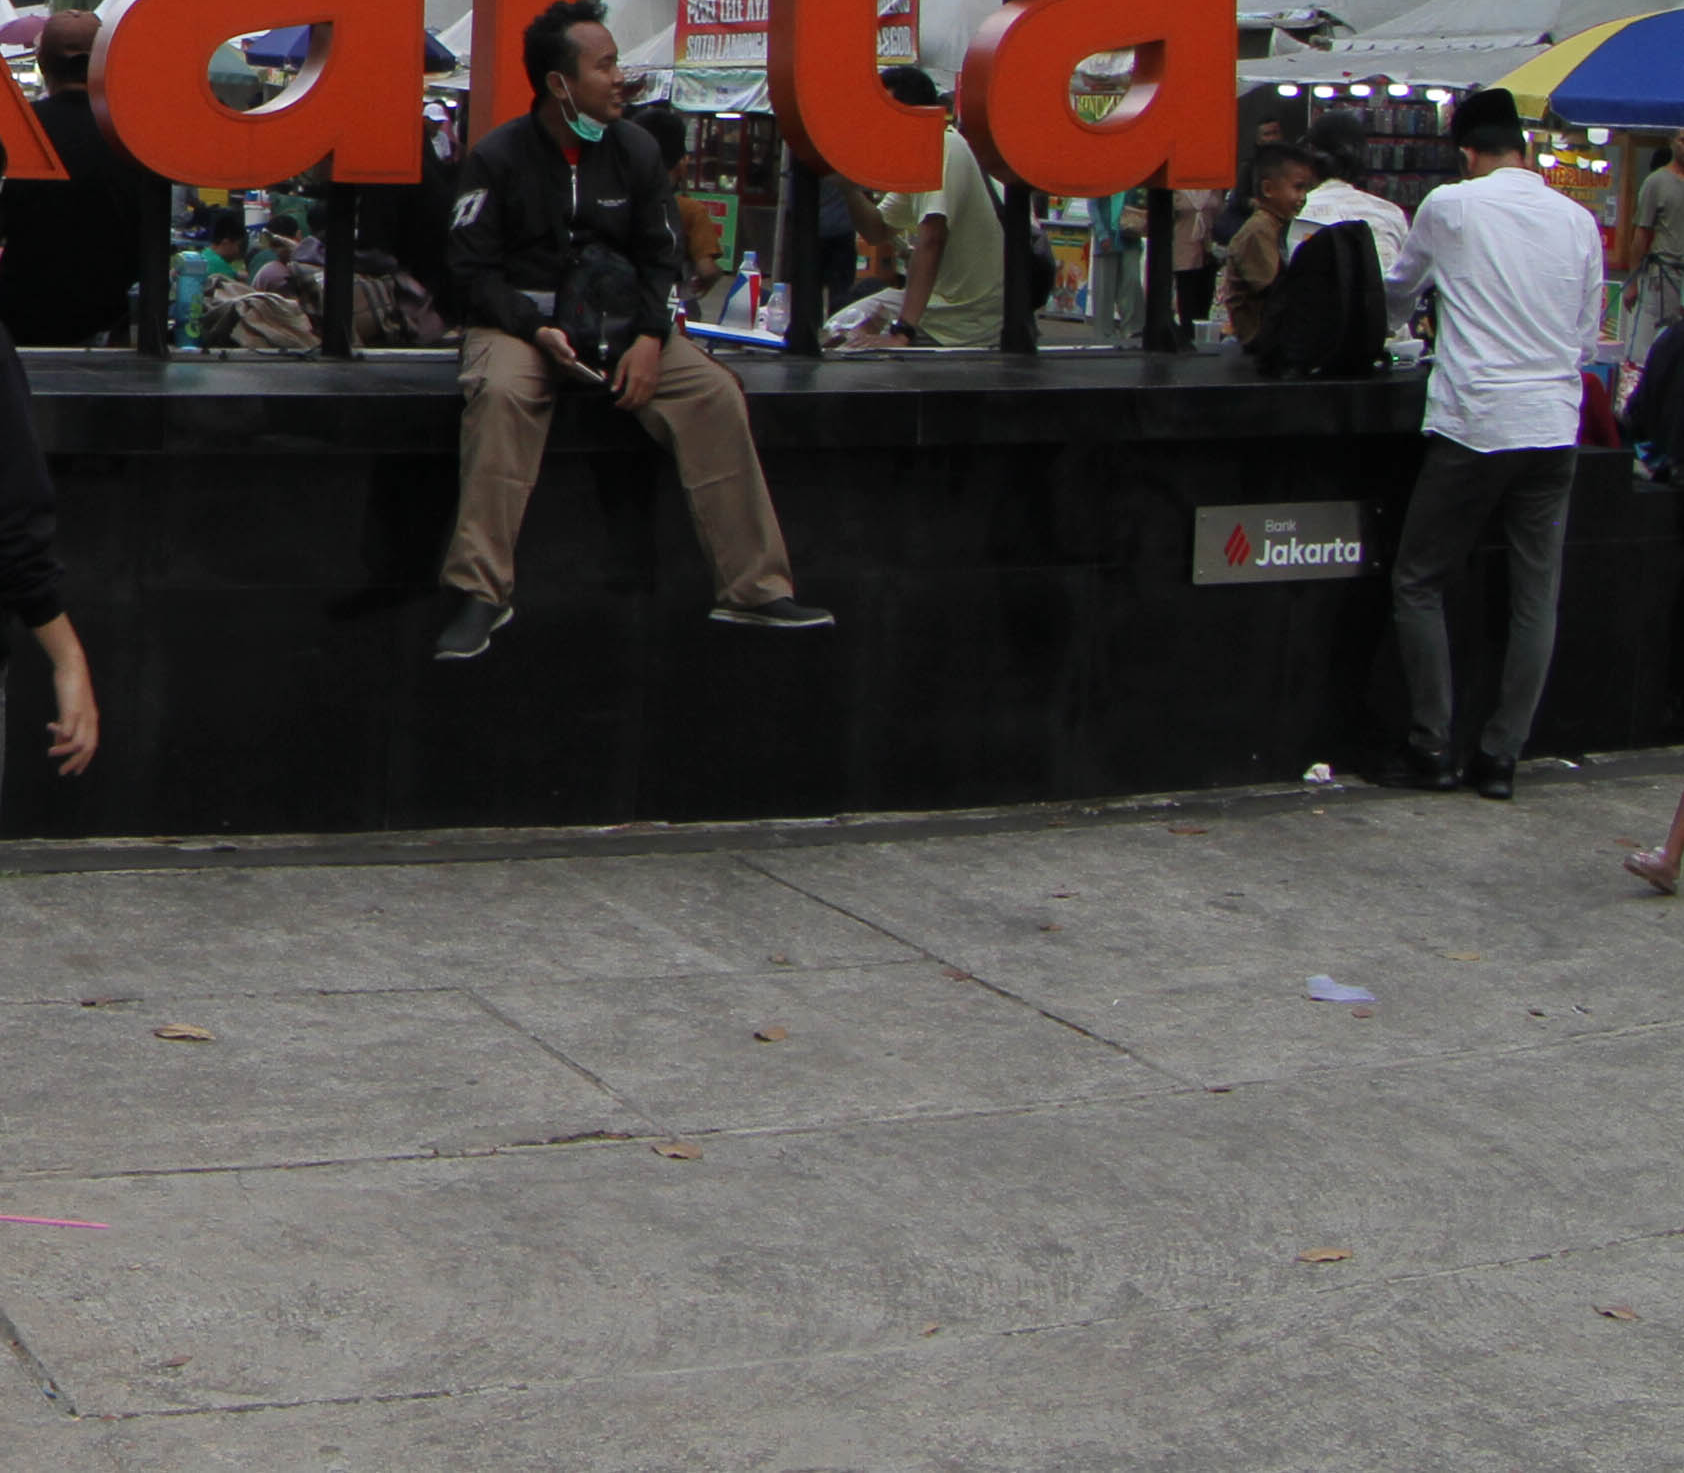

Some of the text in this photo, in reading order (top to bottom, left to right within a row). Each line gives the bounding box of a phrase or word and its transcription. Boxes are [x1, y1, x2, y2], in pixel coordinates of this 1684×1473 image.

[686, 33, 715, 62] SOTO
[1264, 519, 1297, 533] Bank
[1255, 537, 1362, 567] Jakarta
